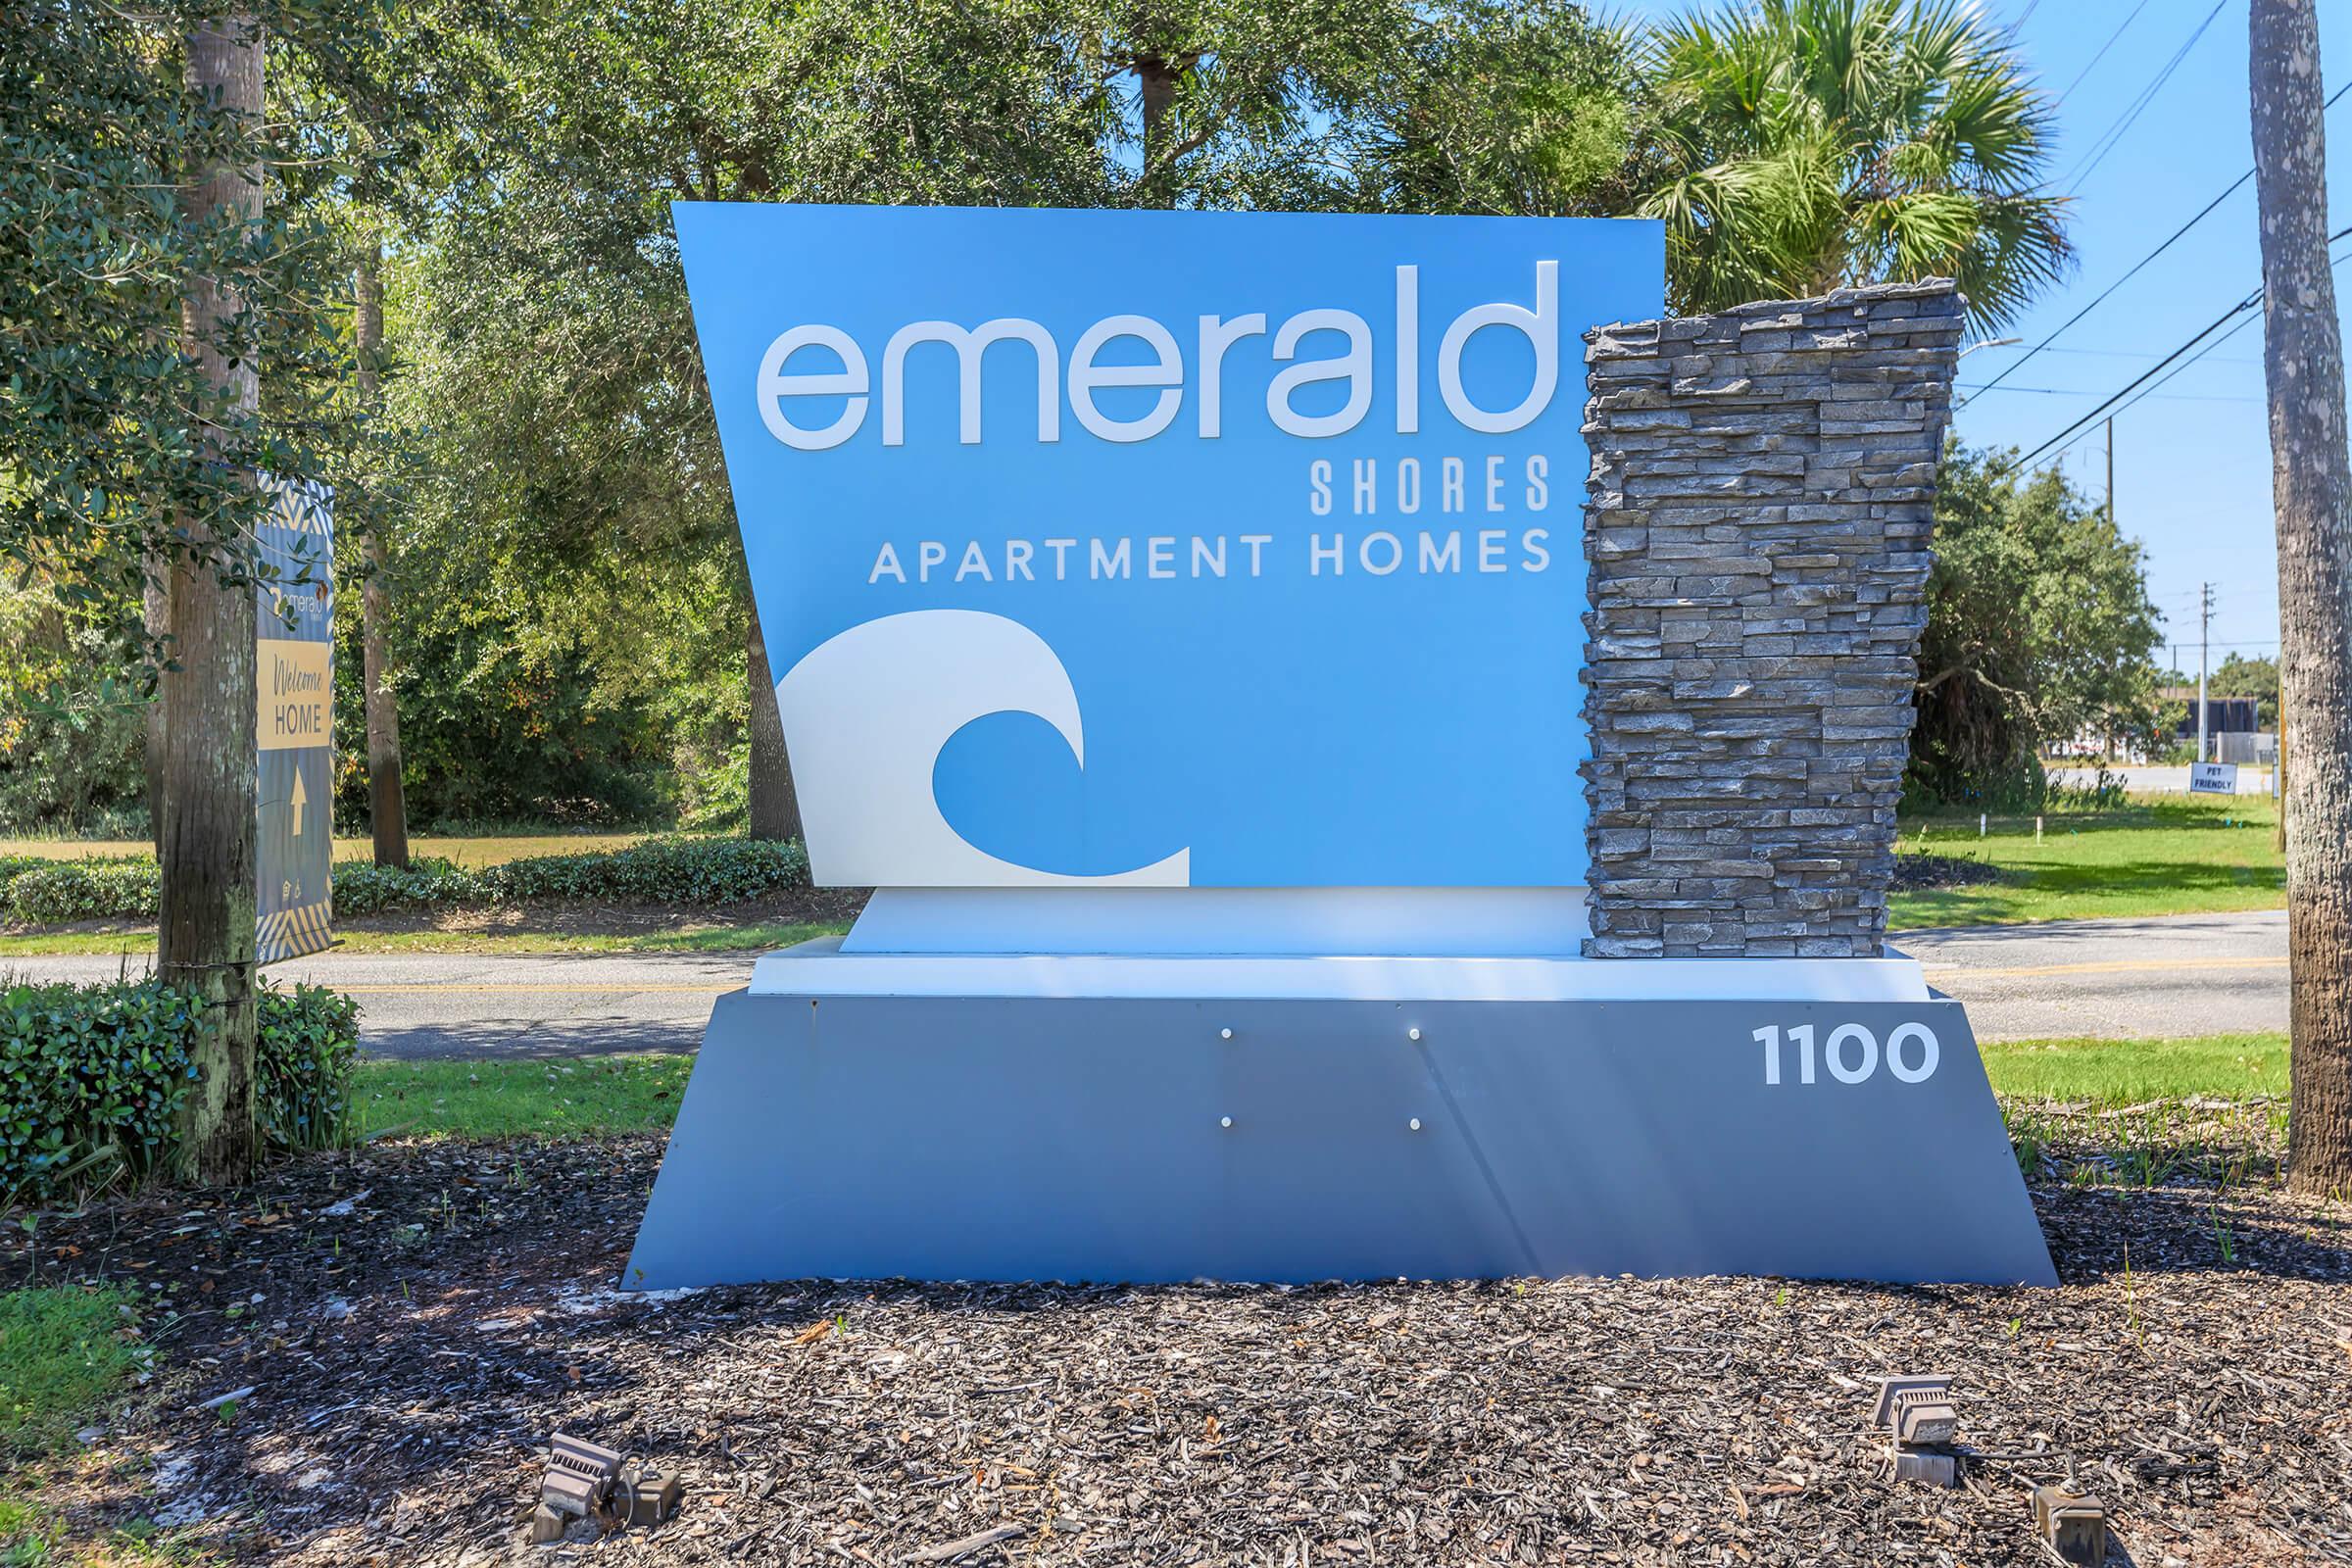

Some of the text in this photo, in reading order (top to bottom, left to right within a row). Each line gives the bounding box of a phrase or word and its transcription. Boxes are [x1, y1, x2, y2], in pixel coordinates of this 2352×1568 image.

[757, 260, 1559, 450] emerald
[1310, 455, 1548, 515] SHORES
[868, 529, 1549, 583] APARTMENT HOMES
[274, 653, 321, 697] Welcome
[275, 704, 321, 735] HOME
[2195, 778, 2231, 790] FRIENDLY
[2207, 766, 2222, 776] PET
[1751, 1022, 1939, 1085] 1100
